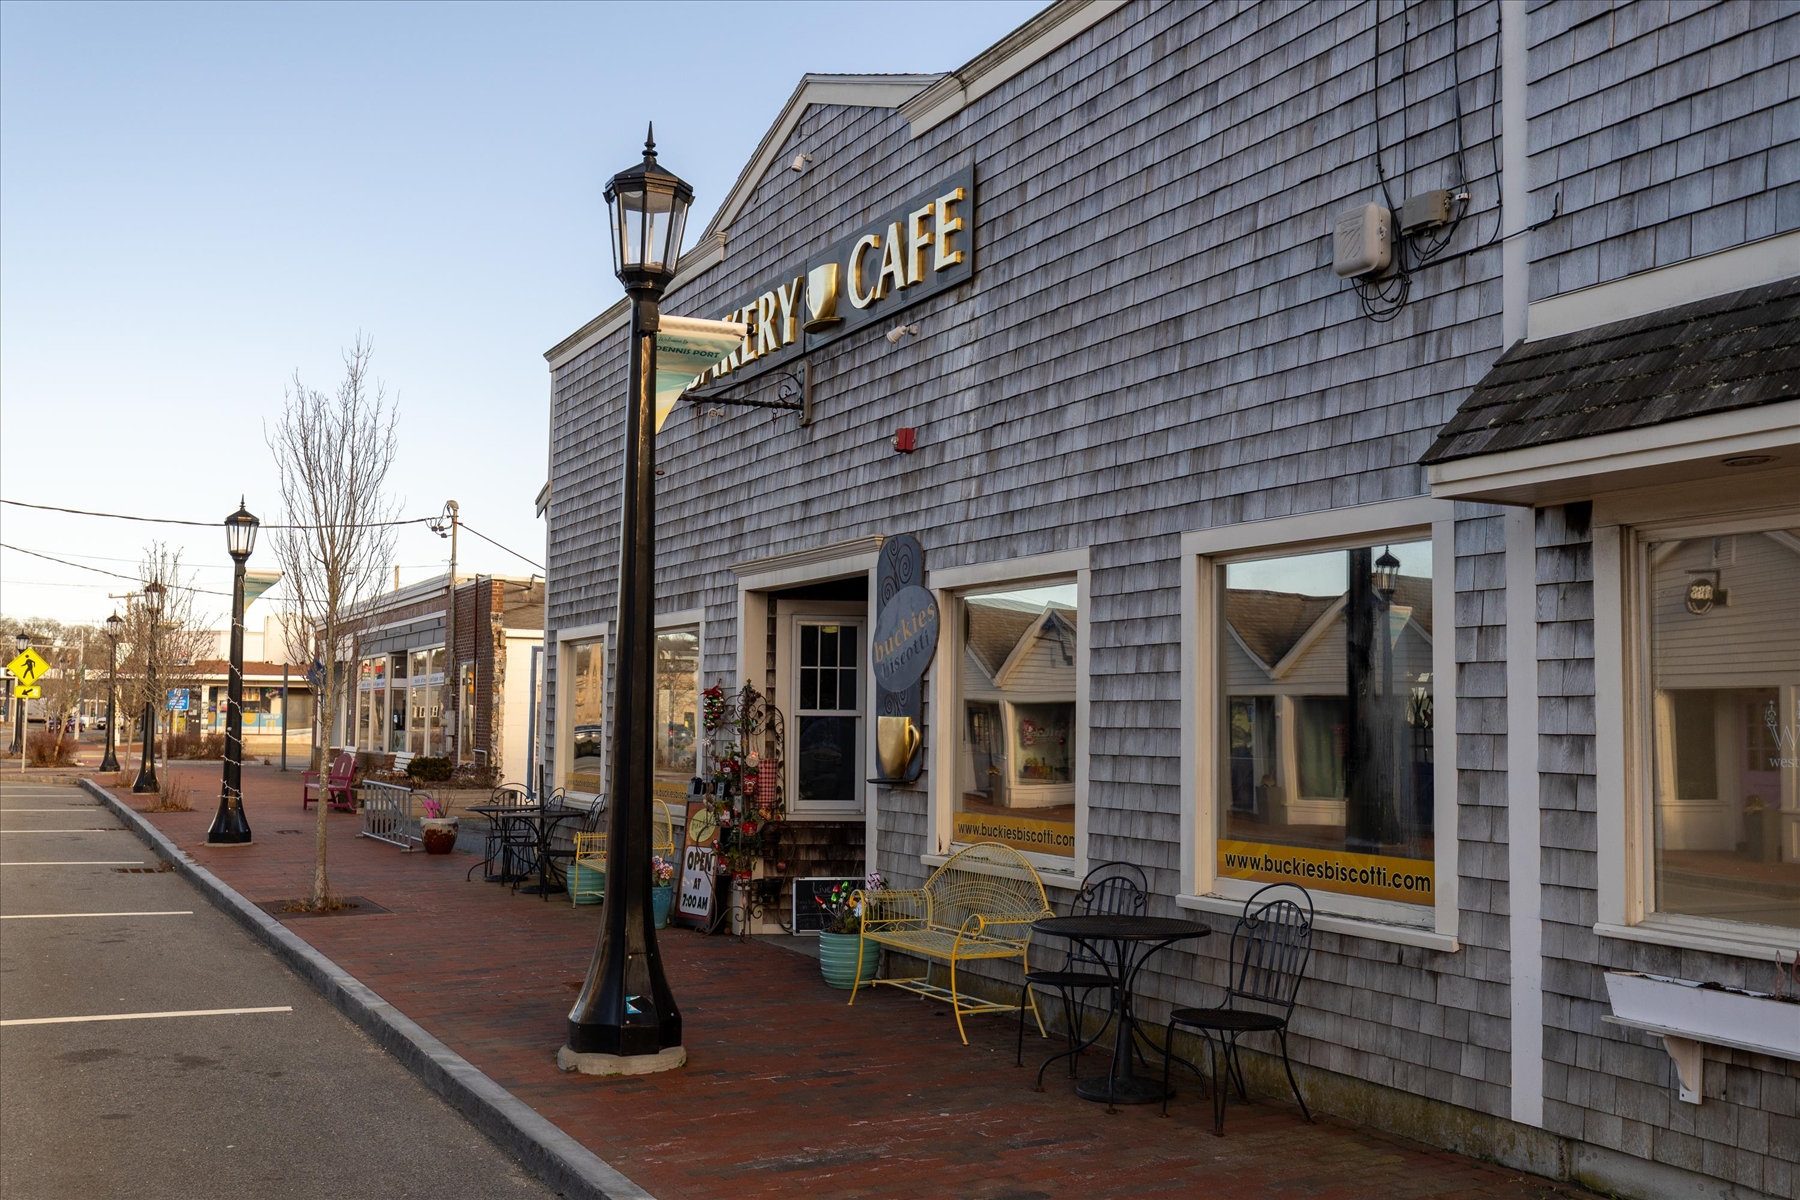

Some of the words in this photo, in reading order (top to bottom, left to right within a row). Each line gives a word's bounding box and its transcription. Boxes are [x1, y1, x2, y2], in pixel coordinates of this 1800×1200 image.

[848, 187, 964, 309] CAFE
[655, 345, 690, 355] DENNIS
[692, 350, 720, 359] PORT
[873, 603, 935, 663] buckies
[881, 630, 930, 679] biscotti
[687, 851, 713, 872] OPEN
[1225, 853, 1431, 892] www.buckiesbiscotti.com
[693, 878, 702, 890] AT
[682, 894, 697, 908] 7:00
[697, 897, 708, 910] AM
